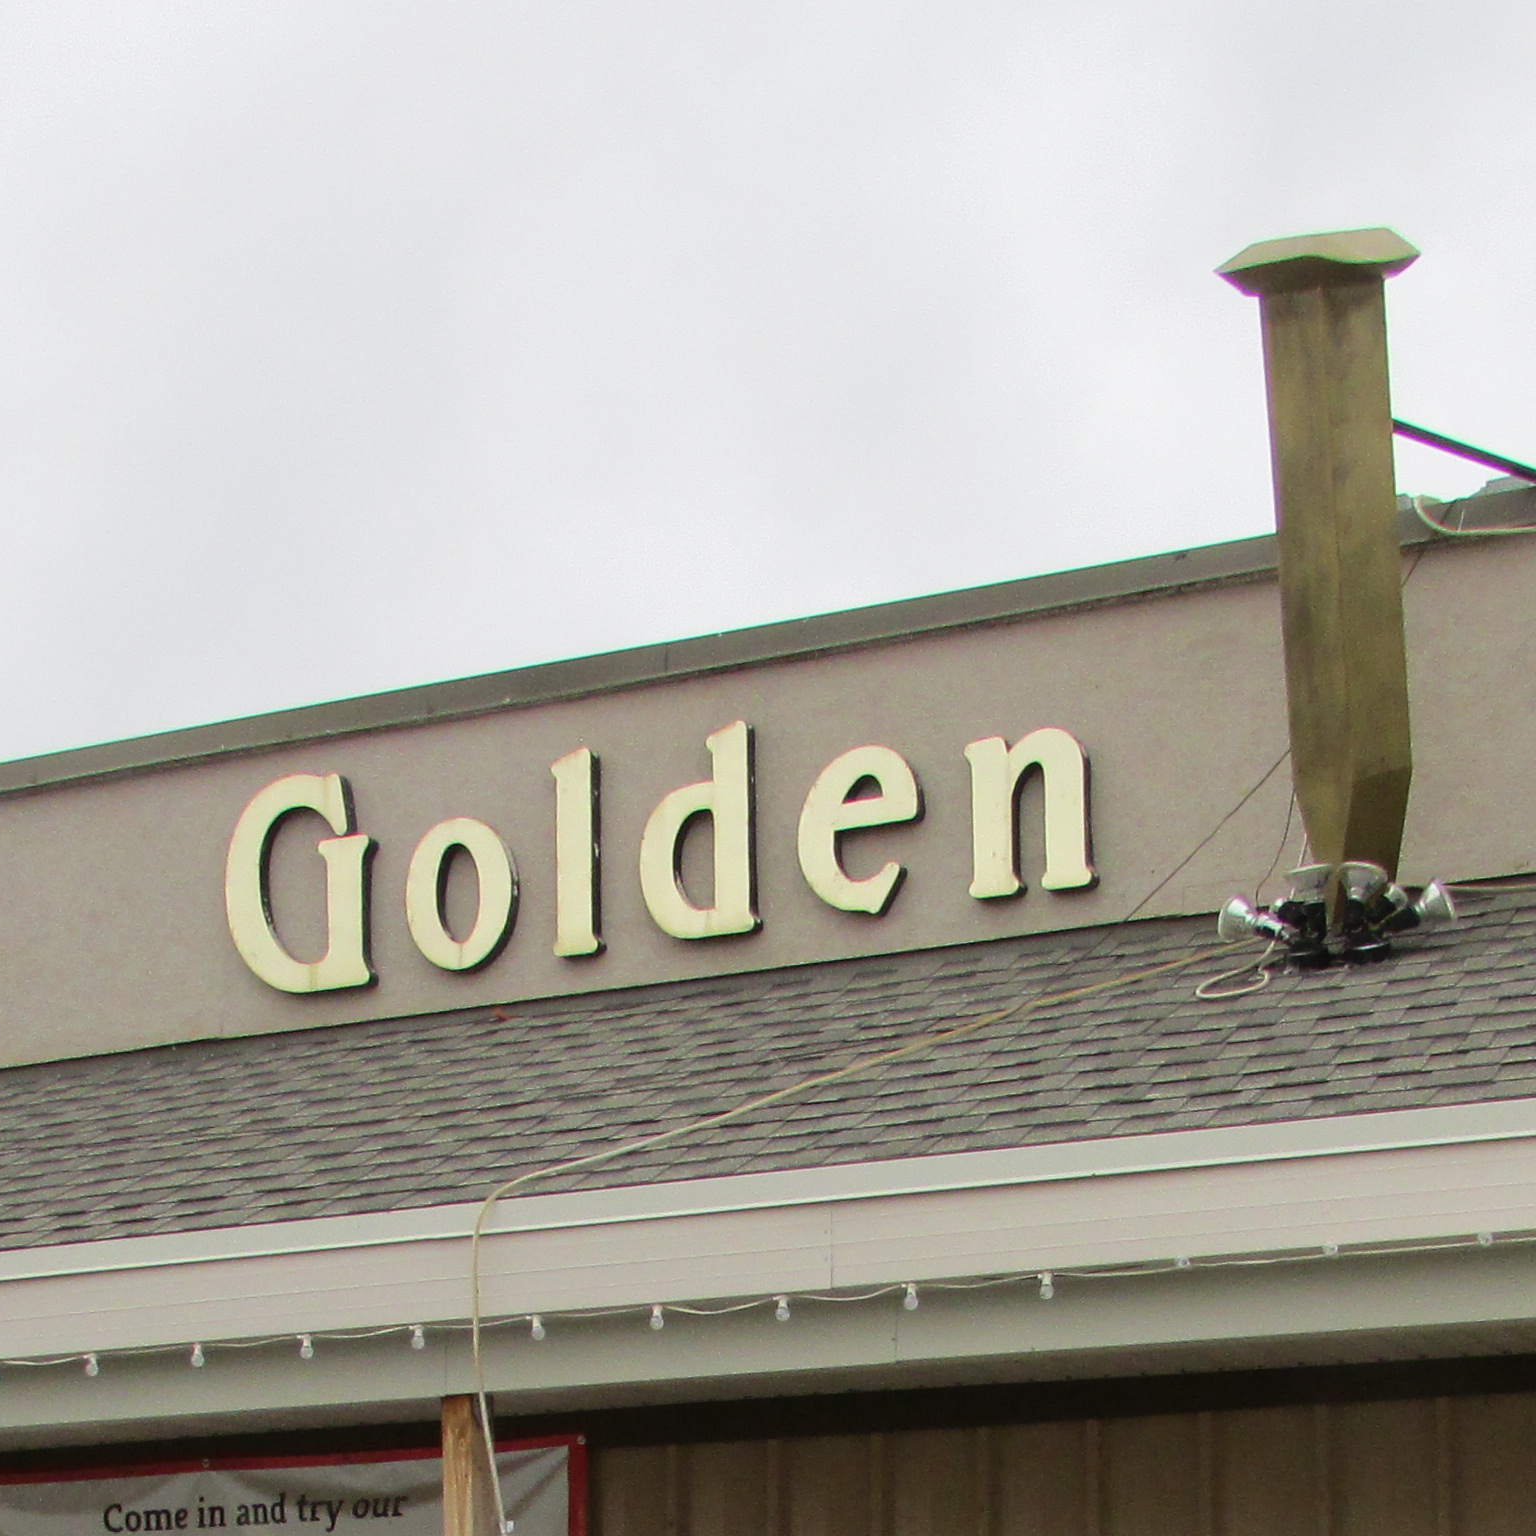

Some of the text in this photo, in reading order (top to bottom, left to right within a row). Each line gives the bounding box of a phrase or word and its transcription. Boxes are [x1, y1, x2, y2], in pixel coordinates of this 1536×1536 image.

[225, 719, 1099, 995] Golden
[103, 1493, 408, 1533] Come in and try our
